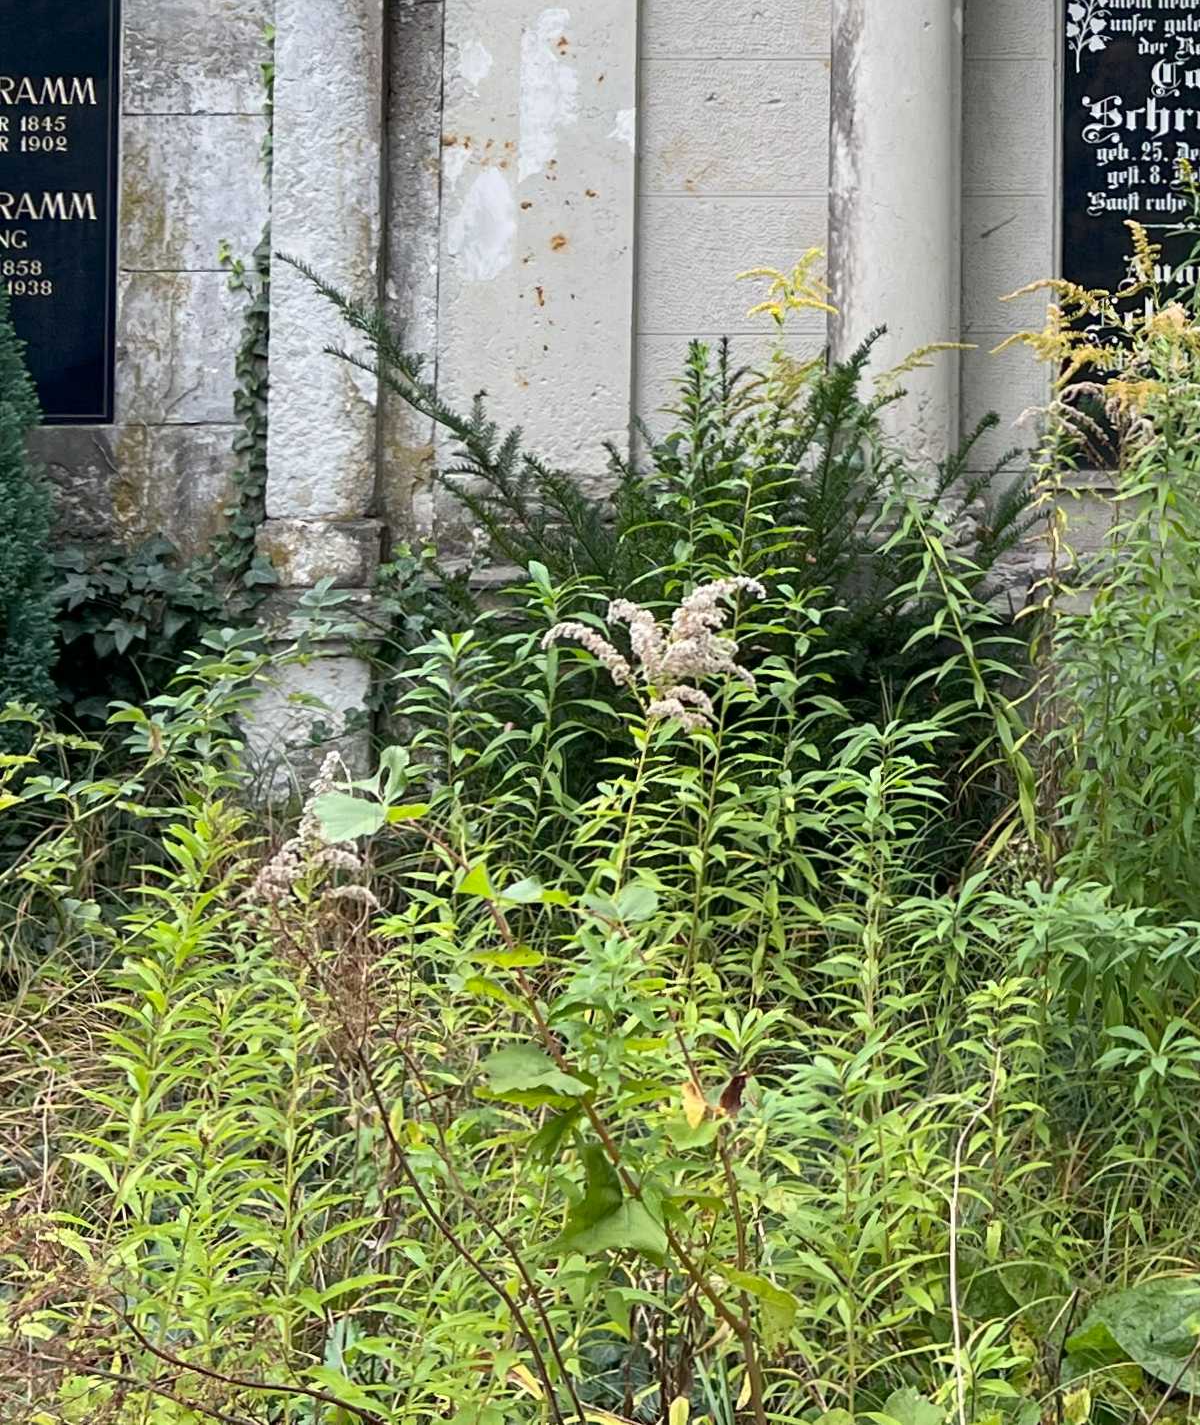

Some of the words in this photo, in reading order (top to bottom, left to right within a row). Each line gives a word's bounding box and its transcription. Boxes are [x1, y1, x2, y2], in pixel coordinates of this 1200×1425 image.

[1137, 37, 1169, 56] der
[20, 115, 68, 132] 1845
[20, 135, 68, 152] 1902
[1096, 142, 1137, 166] geb.
[1140, 141, 1170, 163] 25.
[1149, 165, 1168, 185] 8.
[8, 279, 52, 296] 1938
